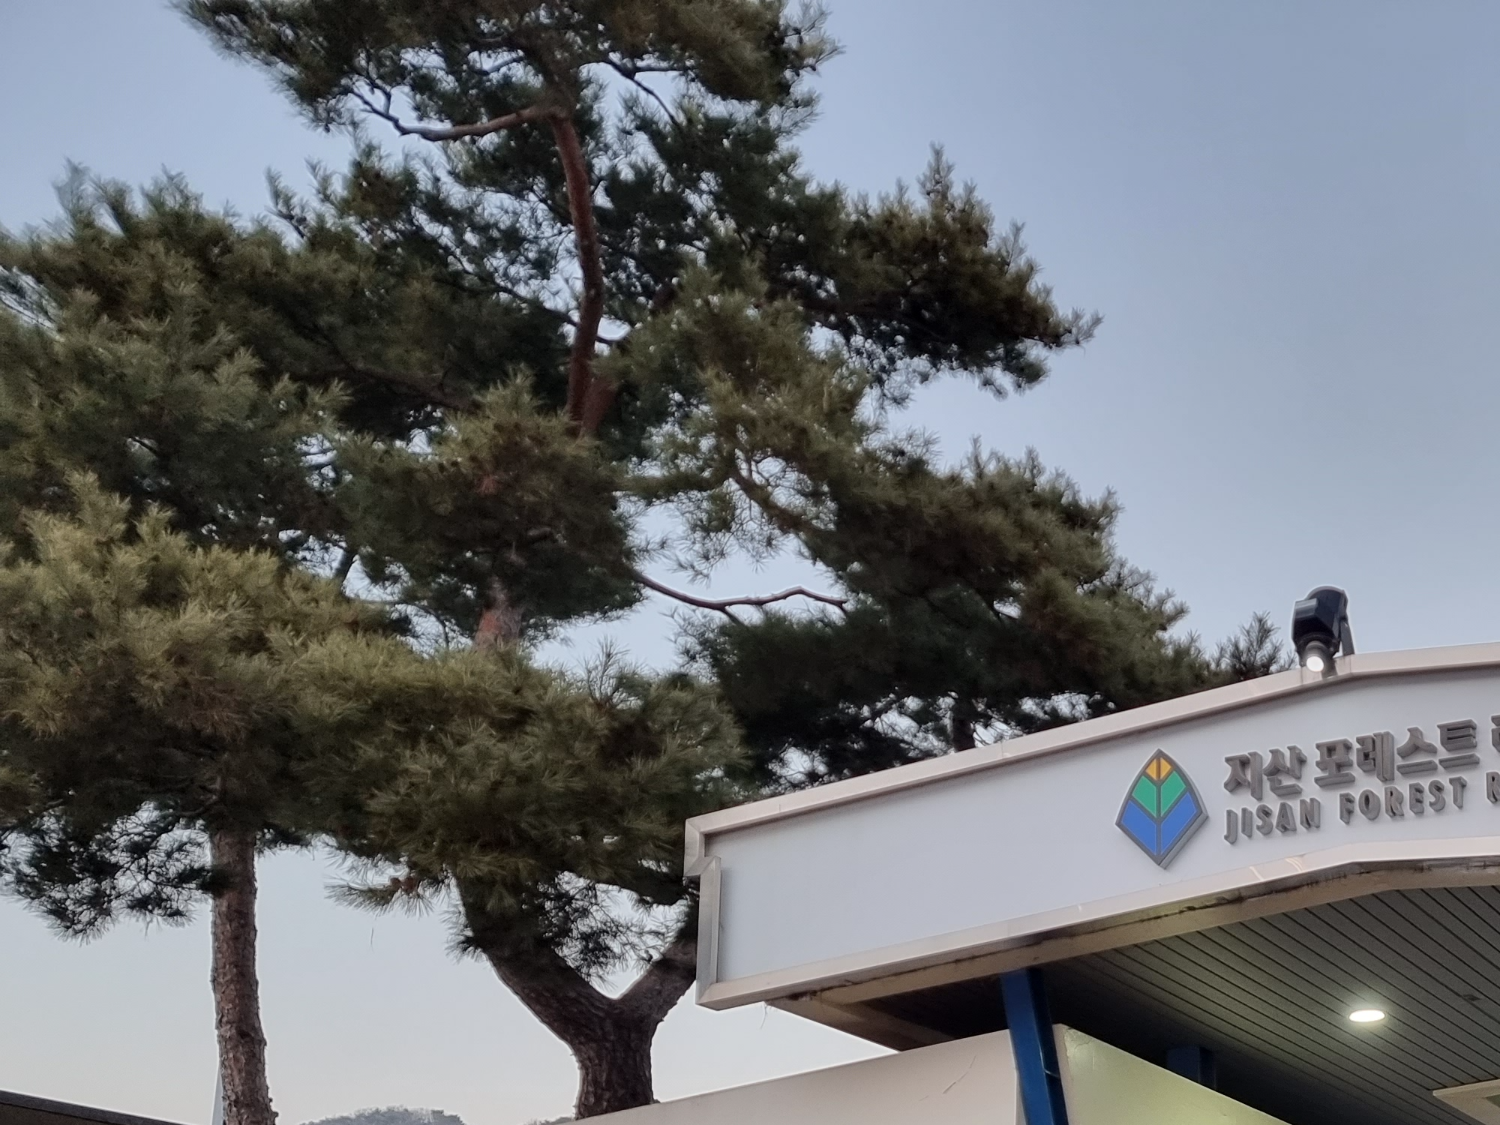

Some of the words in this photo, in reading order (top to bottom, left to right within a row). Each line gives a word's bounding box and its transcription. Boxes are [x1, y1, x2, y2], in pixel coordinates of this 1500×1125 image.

[1224, 745, 1307, 800] 지산
[1314, 718, 1481, 787] 포레스트
[1224, 798, 1320, 844] JISAN
[1340, 776, 1468, 824] FOREST
